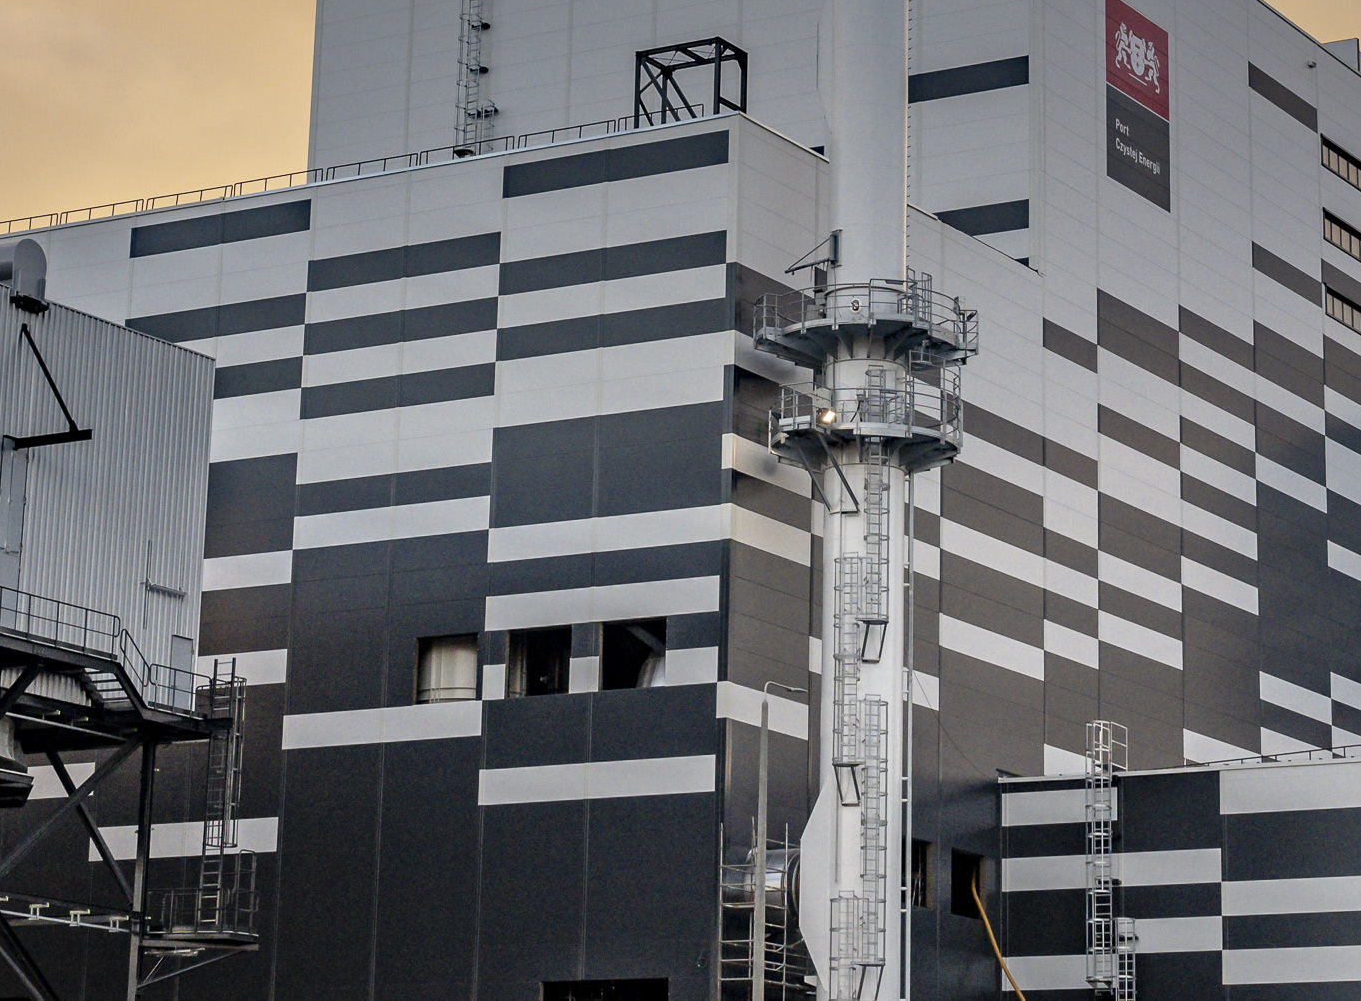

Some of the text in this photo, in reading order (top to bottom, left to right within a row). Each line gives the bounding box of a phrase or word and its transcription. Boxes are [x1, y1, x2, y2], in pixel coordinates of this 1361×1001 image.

[1115, 118, 1129, 136] Port
[1115, 138, 1160, 174] Czystej Energii
